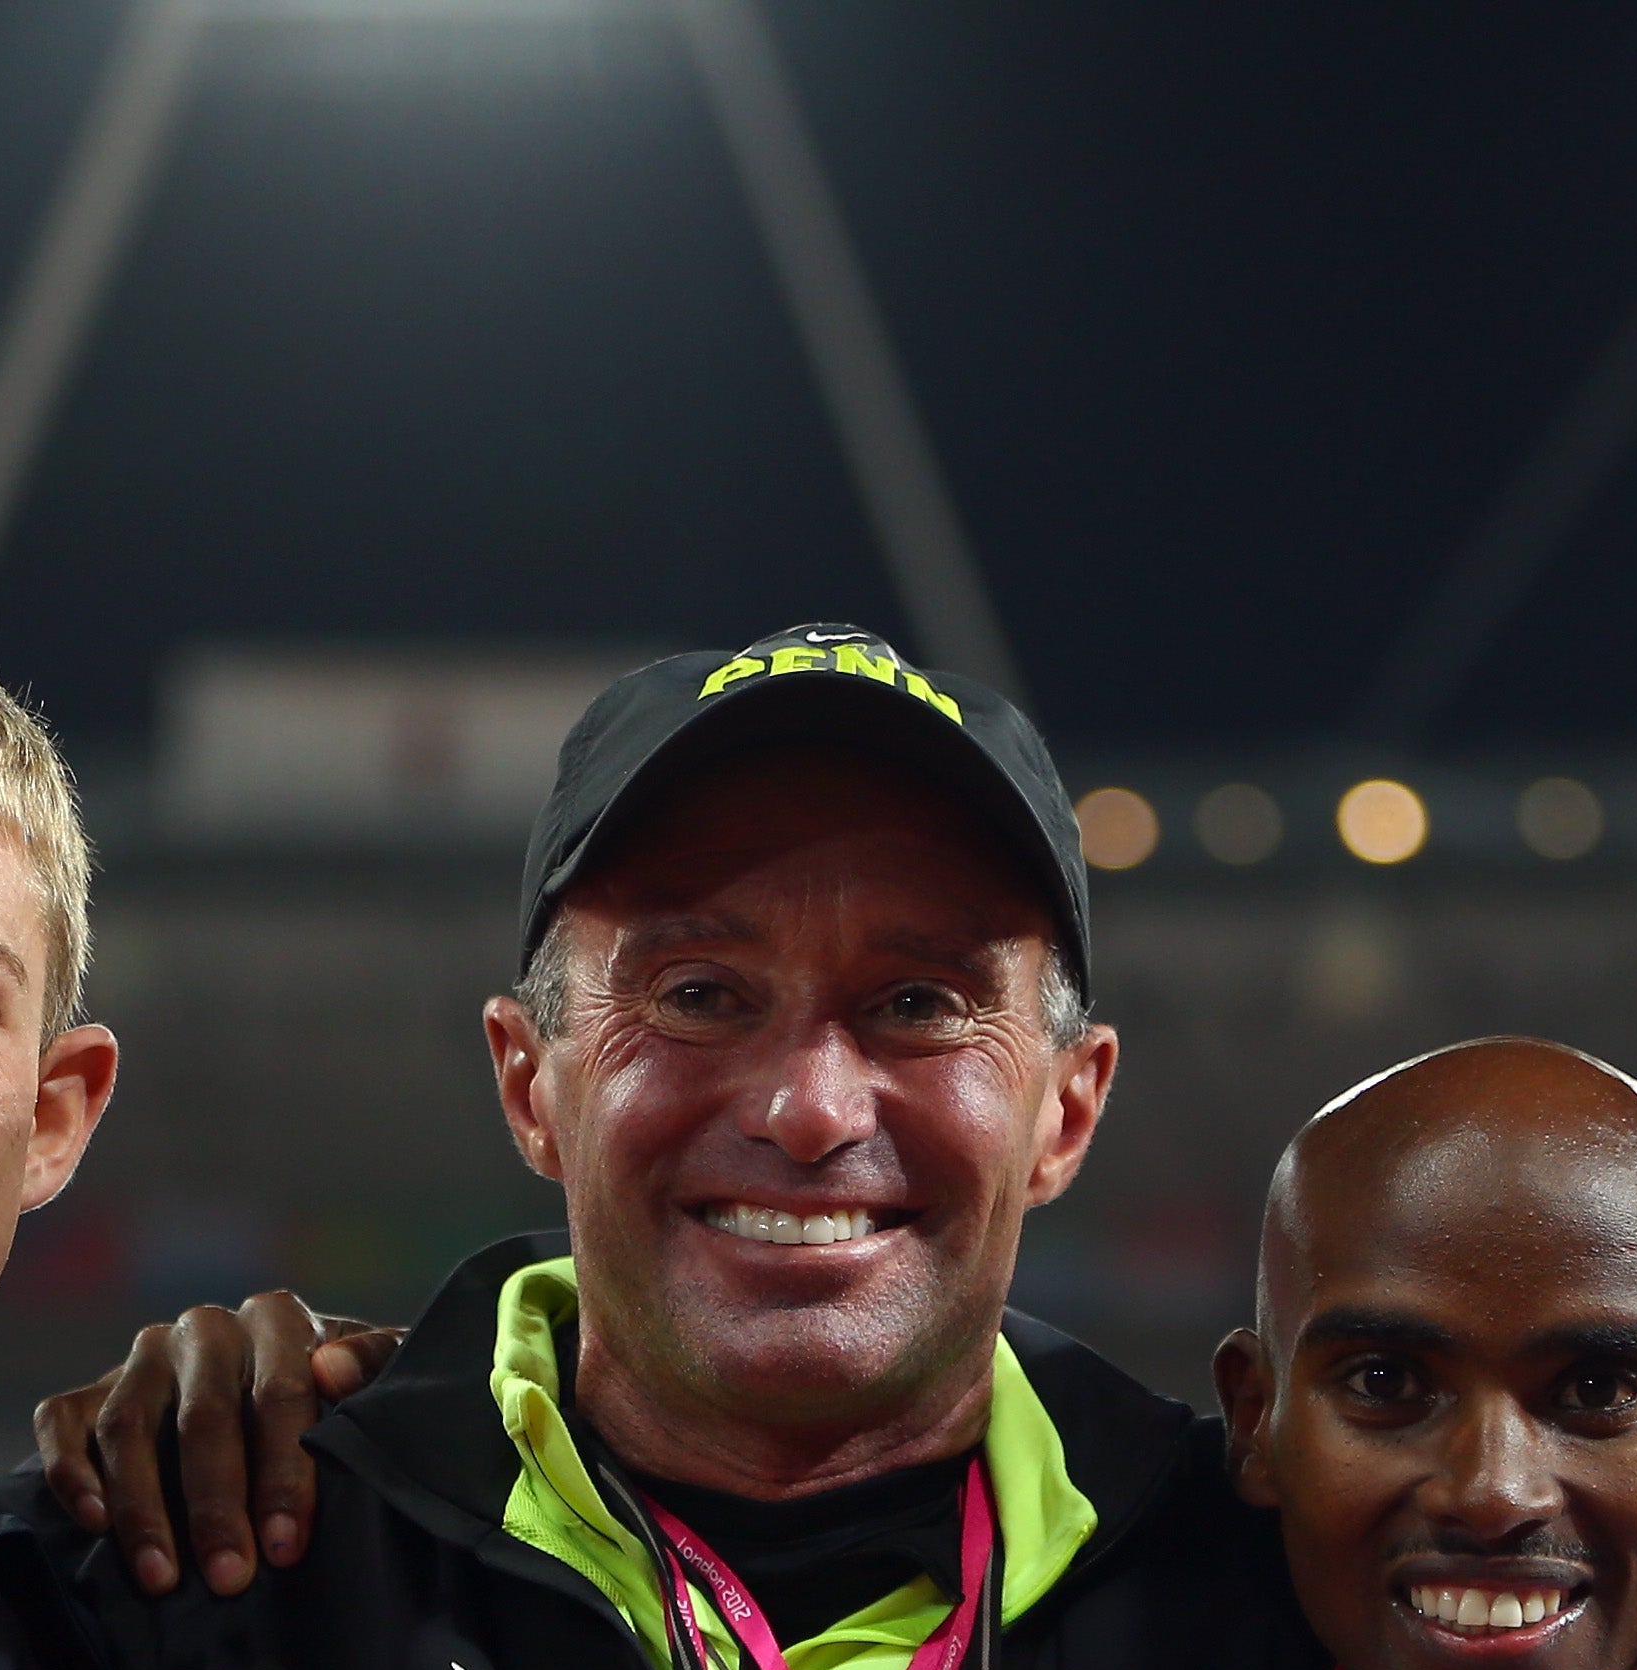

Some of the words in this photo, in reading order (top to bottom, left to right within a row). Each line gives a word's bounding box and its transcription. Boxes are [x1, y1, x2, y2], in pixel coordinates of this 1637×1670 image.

[695, 643, 962, 726] PENN
[677, 1537, 726, 1590] London
[723, 1585, 751, 1622] 2012
